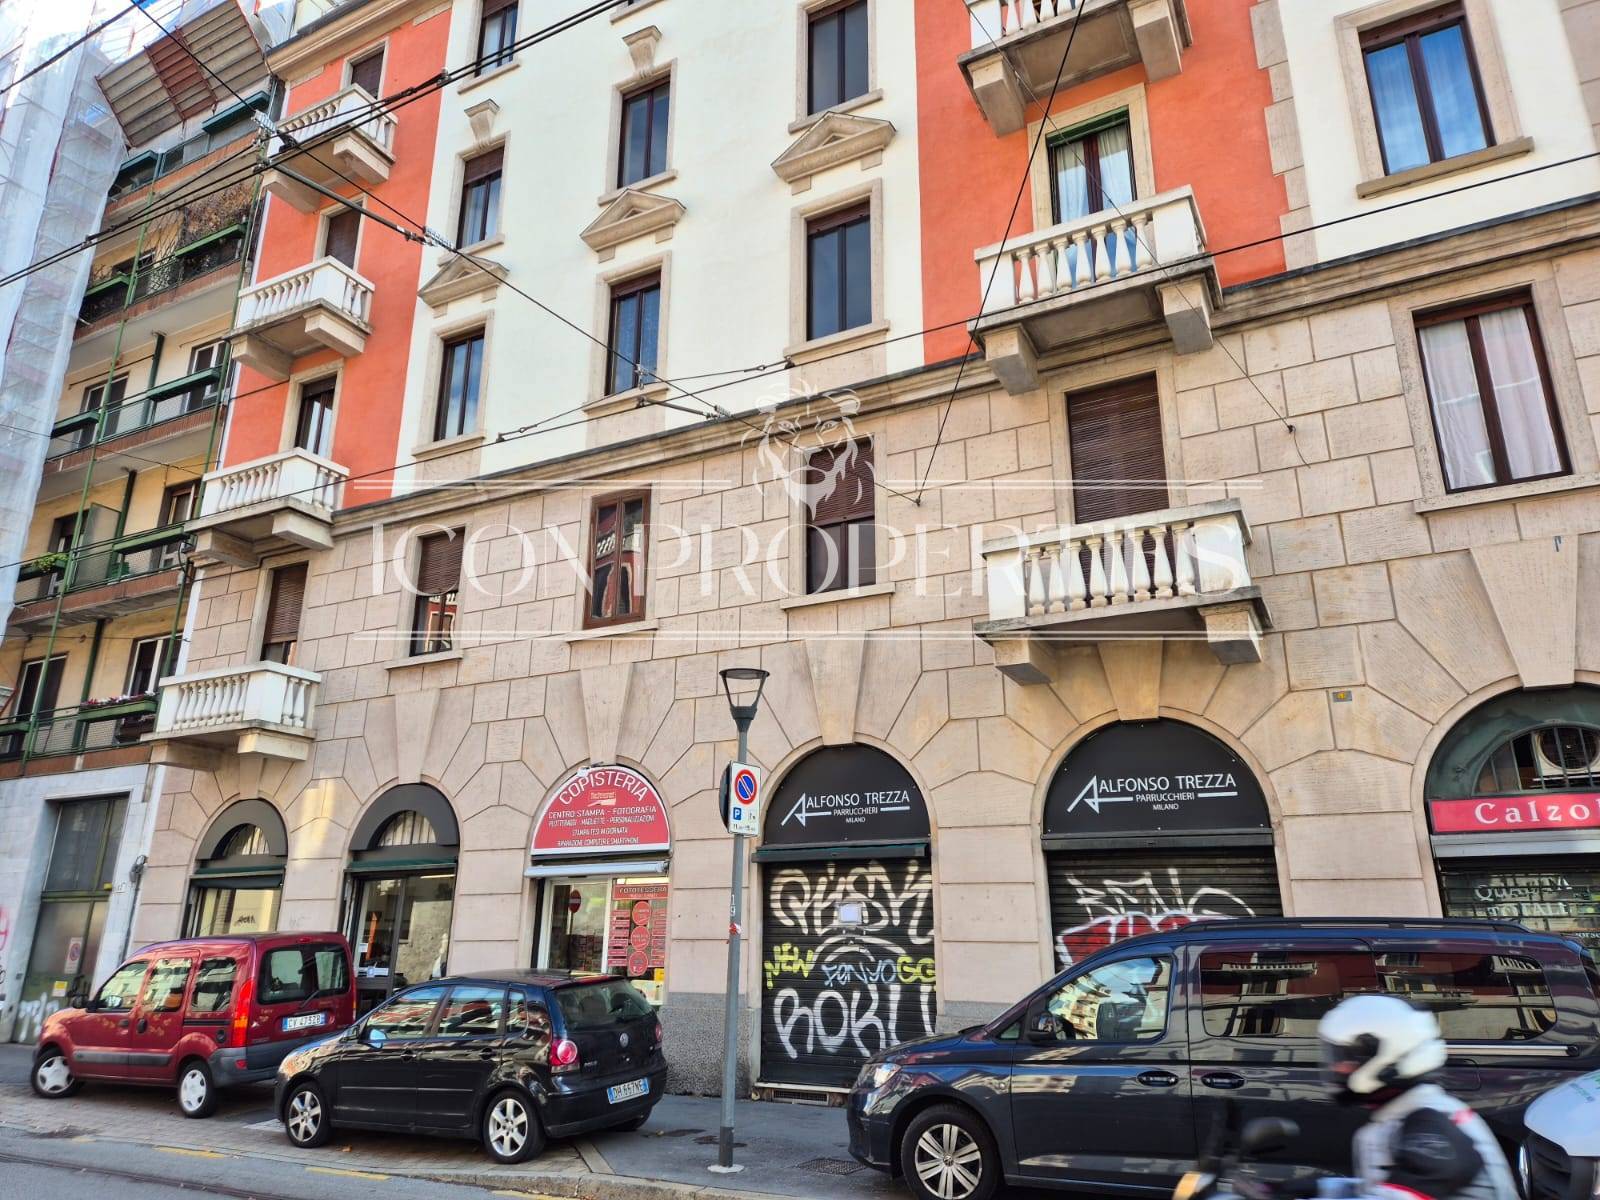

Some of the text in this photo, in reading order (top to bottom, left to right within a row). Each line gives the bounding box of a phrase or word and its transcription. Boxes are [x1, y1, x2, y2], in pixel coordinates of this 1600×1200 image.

[560, 771, 648, 805] COPISTERIA
[1099, 773, 1236, 793] ALFONSO TREZZA
[806, 790, 910, 809] ALFONSO TREZZA
[1136, 792, 1195, 803] PARRUCCHIERI
[548, 805, 657, 819] CENTRO STAMPA FOTOGRAFIA
[833, 806, 878, 816] PARRUCCHIERI
[1153, 803, 1179, 811] MILANO
